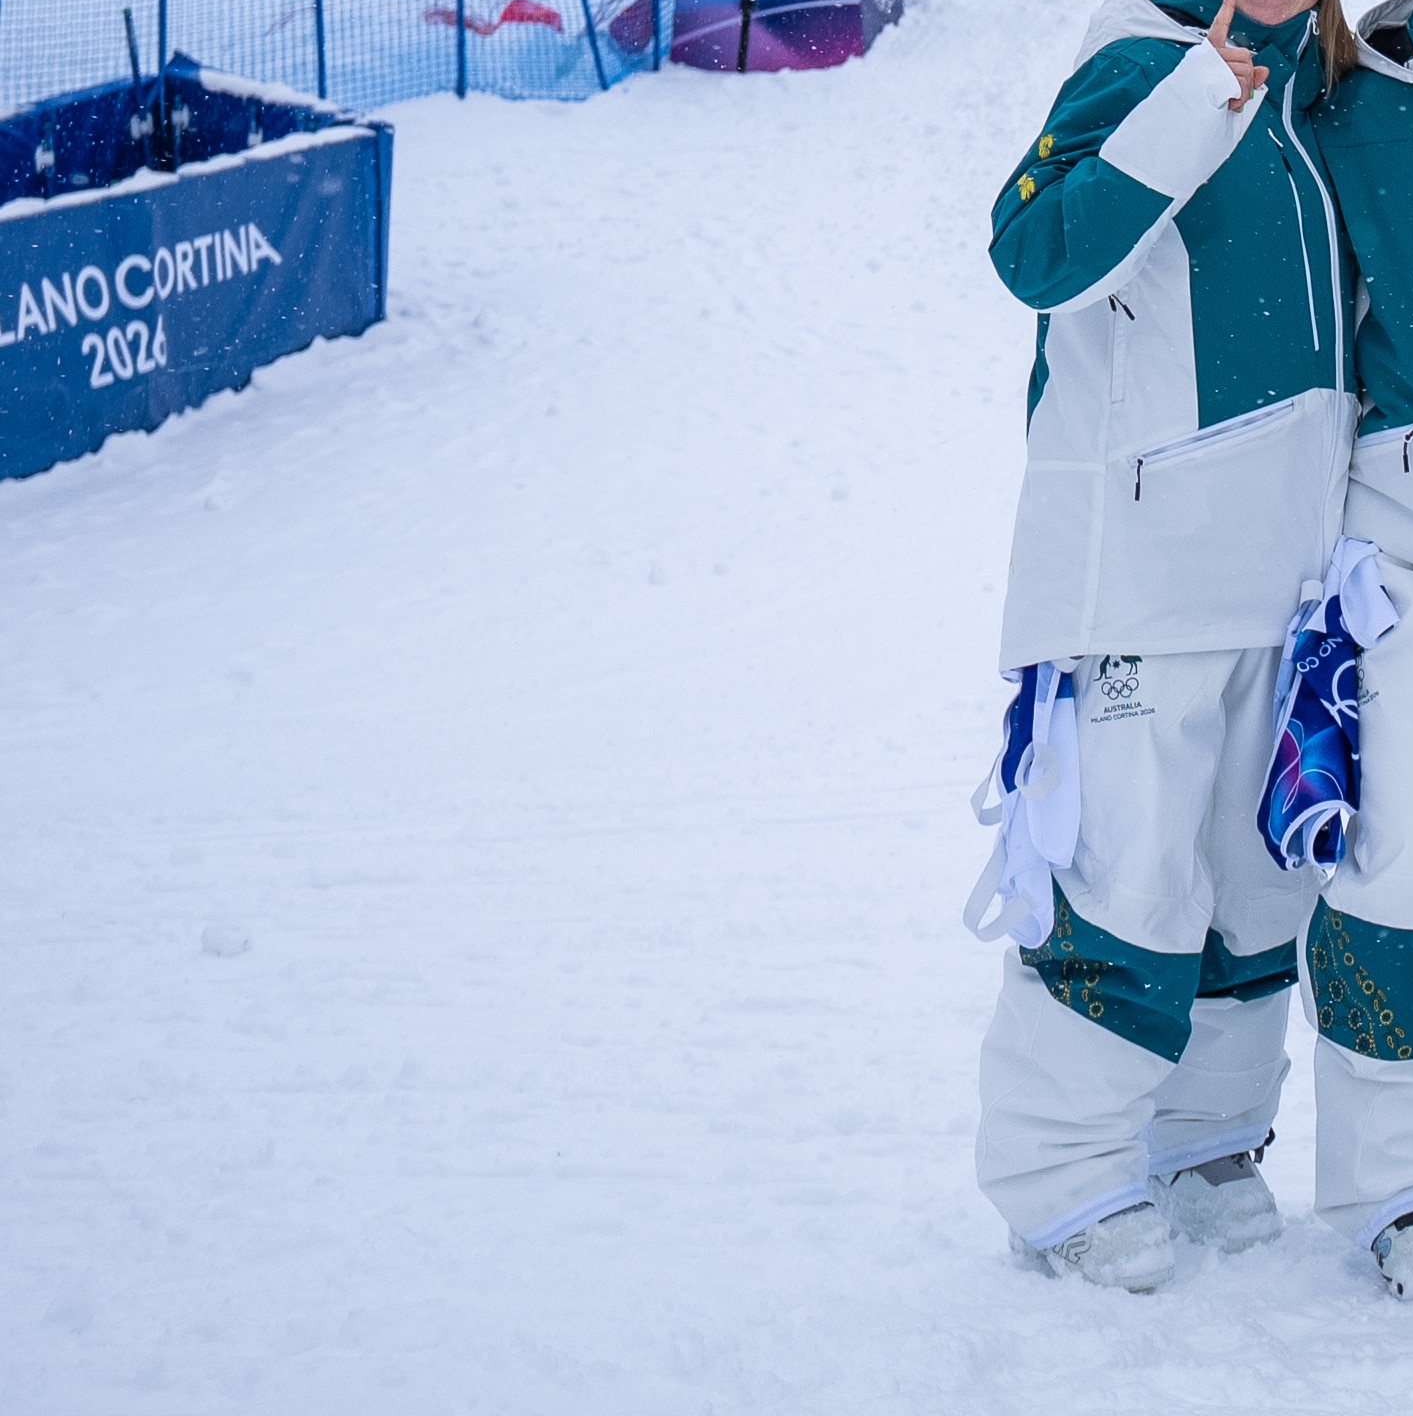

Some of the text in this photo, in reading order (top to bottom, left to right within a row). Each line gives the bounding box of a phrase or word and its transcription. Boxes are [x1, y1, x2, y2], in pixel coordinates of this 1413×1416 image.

[115, 221, 283, 310] CORTINA
[81, 313, 168, 390] 2026
[1090, 706, 1156, 724] MILANO CORTINA 2026
[1103, 701, 1142, 714] AUSTRALIA
